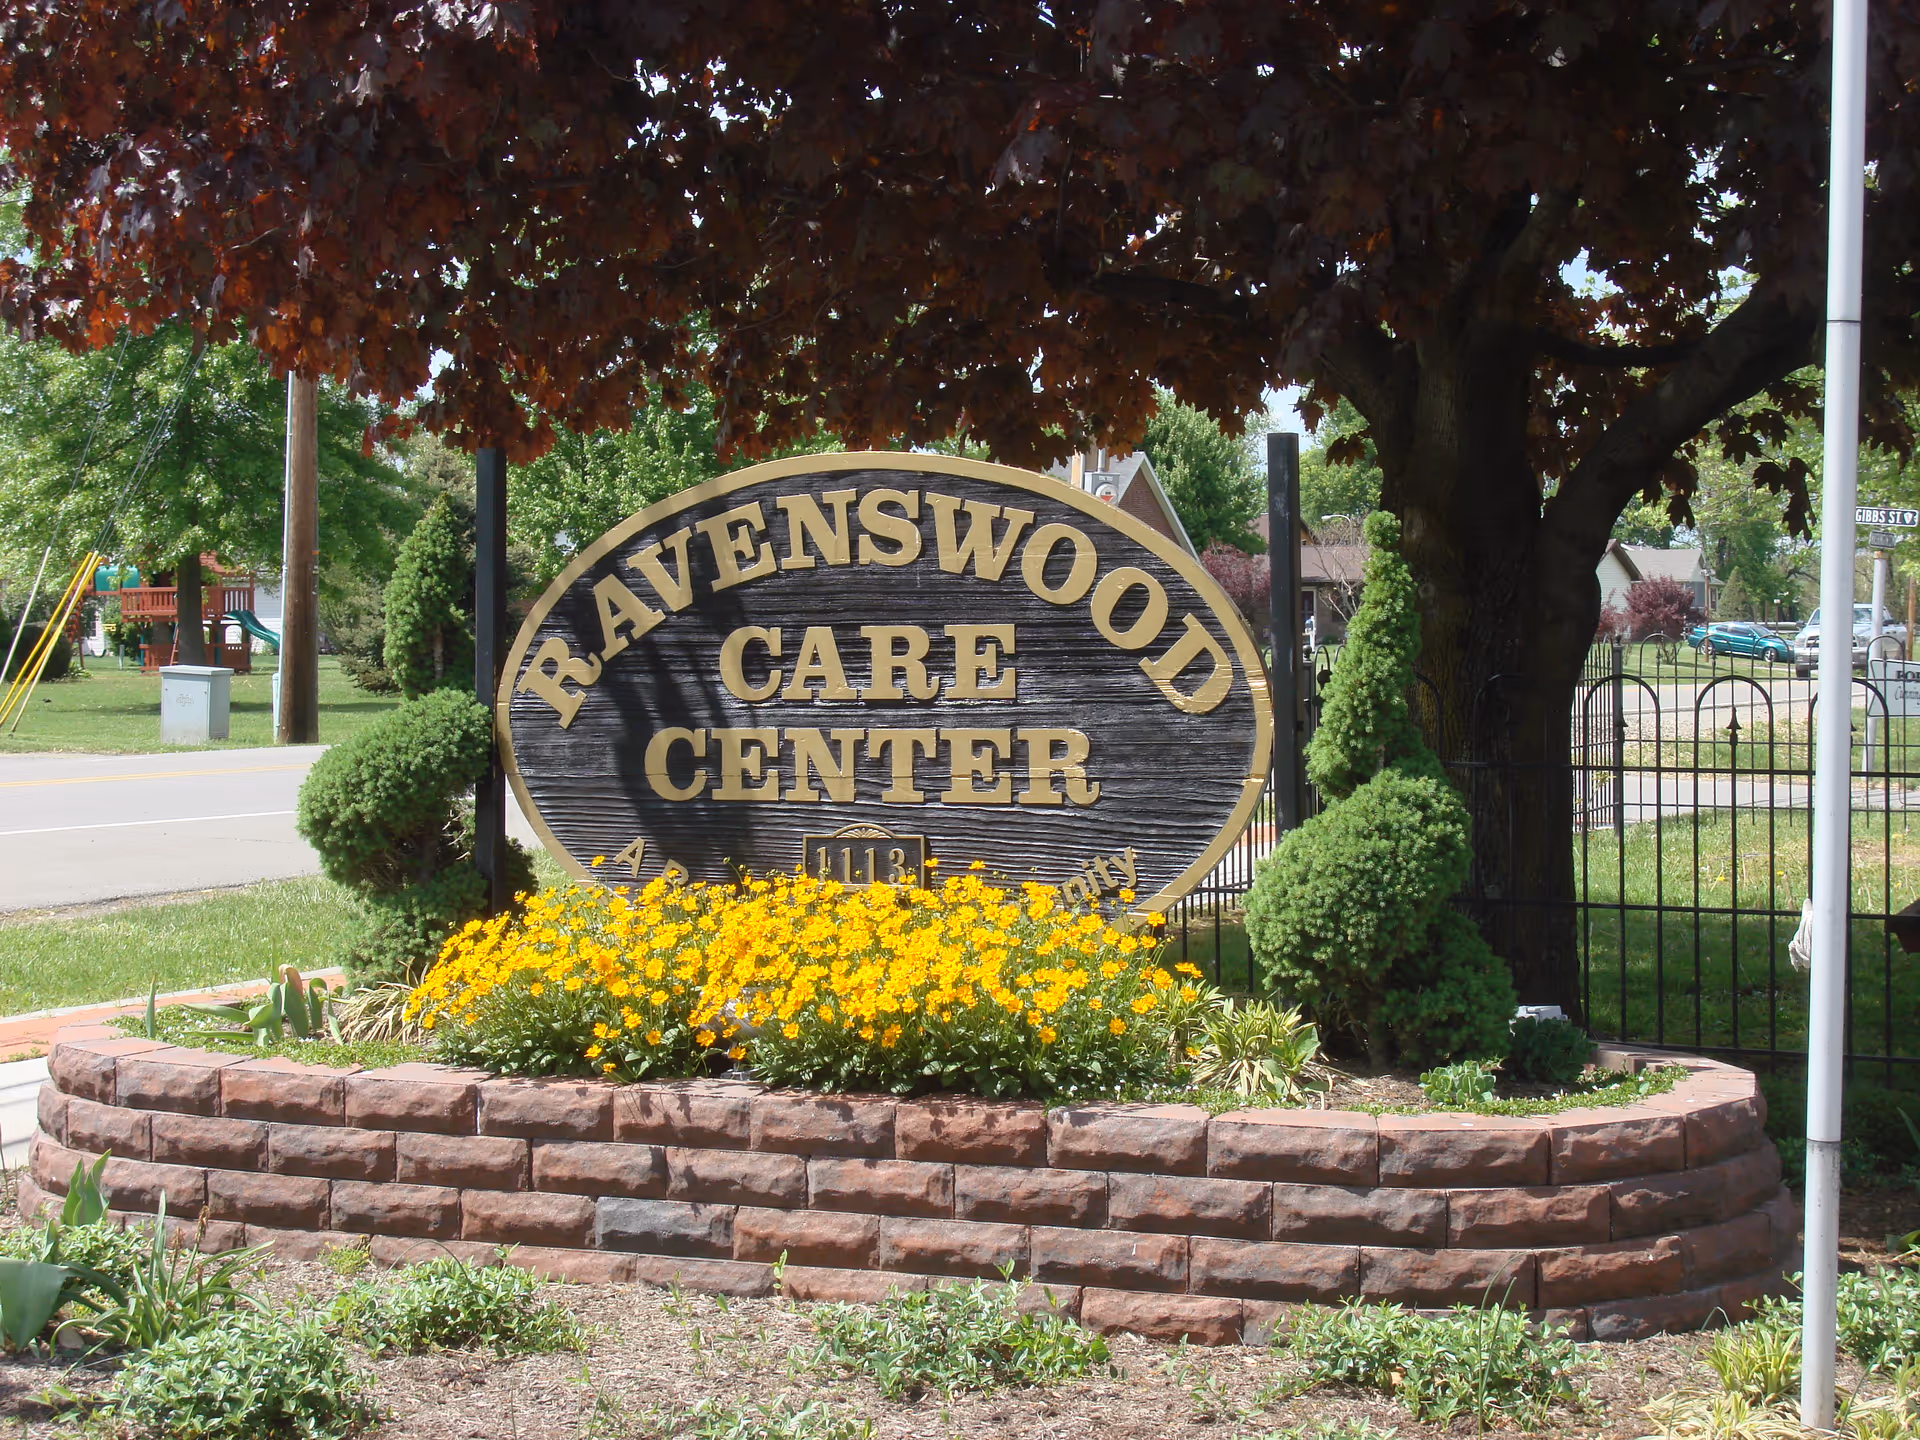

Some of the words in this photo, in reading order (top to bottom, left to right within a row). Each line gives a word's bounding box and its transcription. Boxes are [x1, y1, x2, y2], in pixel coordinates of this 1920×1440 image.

[1855, 509, 1886, 523] GIBBS
[1888, 511, 1903, 524] ST
[516, 488, 1234, 729] RAVENSWOOD
[719, 624, 1017, 701] CARE
[644, 727, 1100, 806] CENTER
[613, 836, 645, 868] A
[816, 847, 906, 885] 1113
